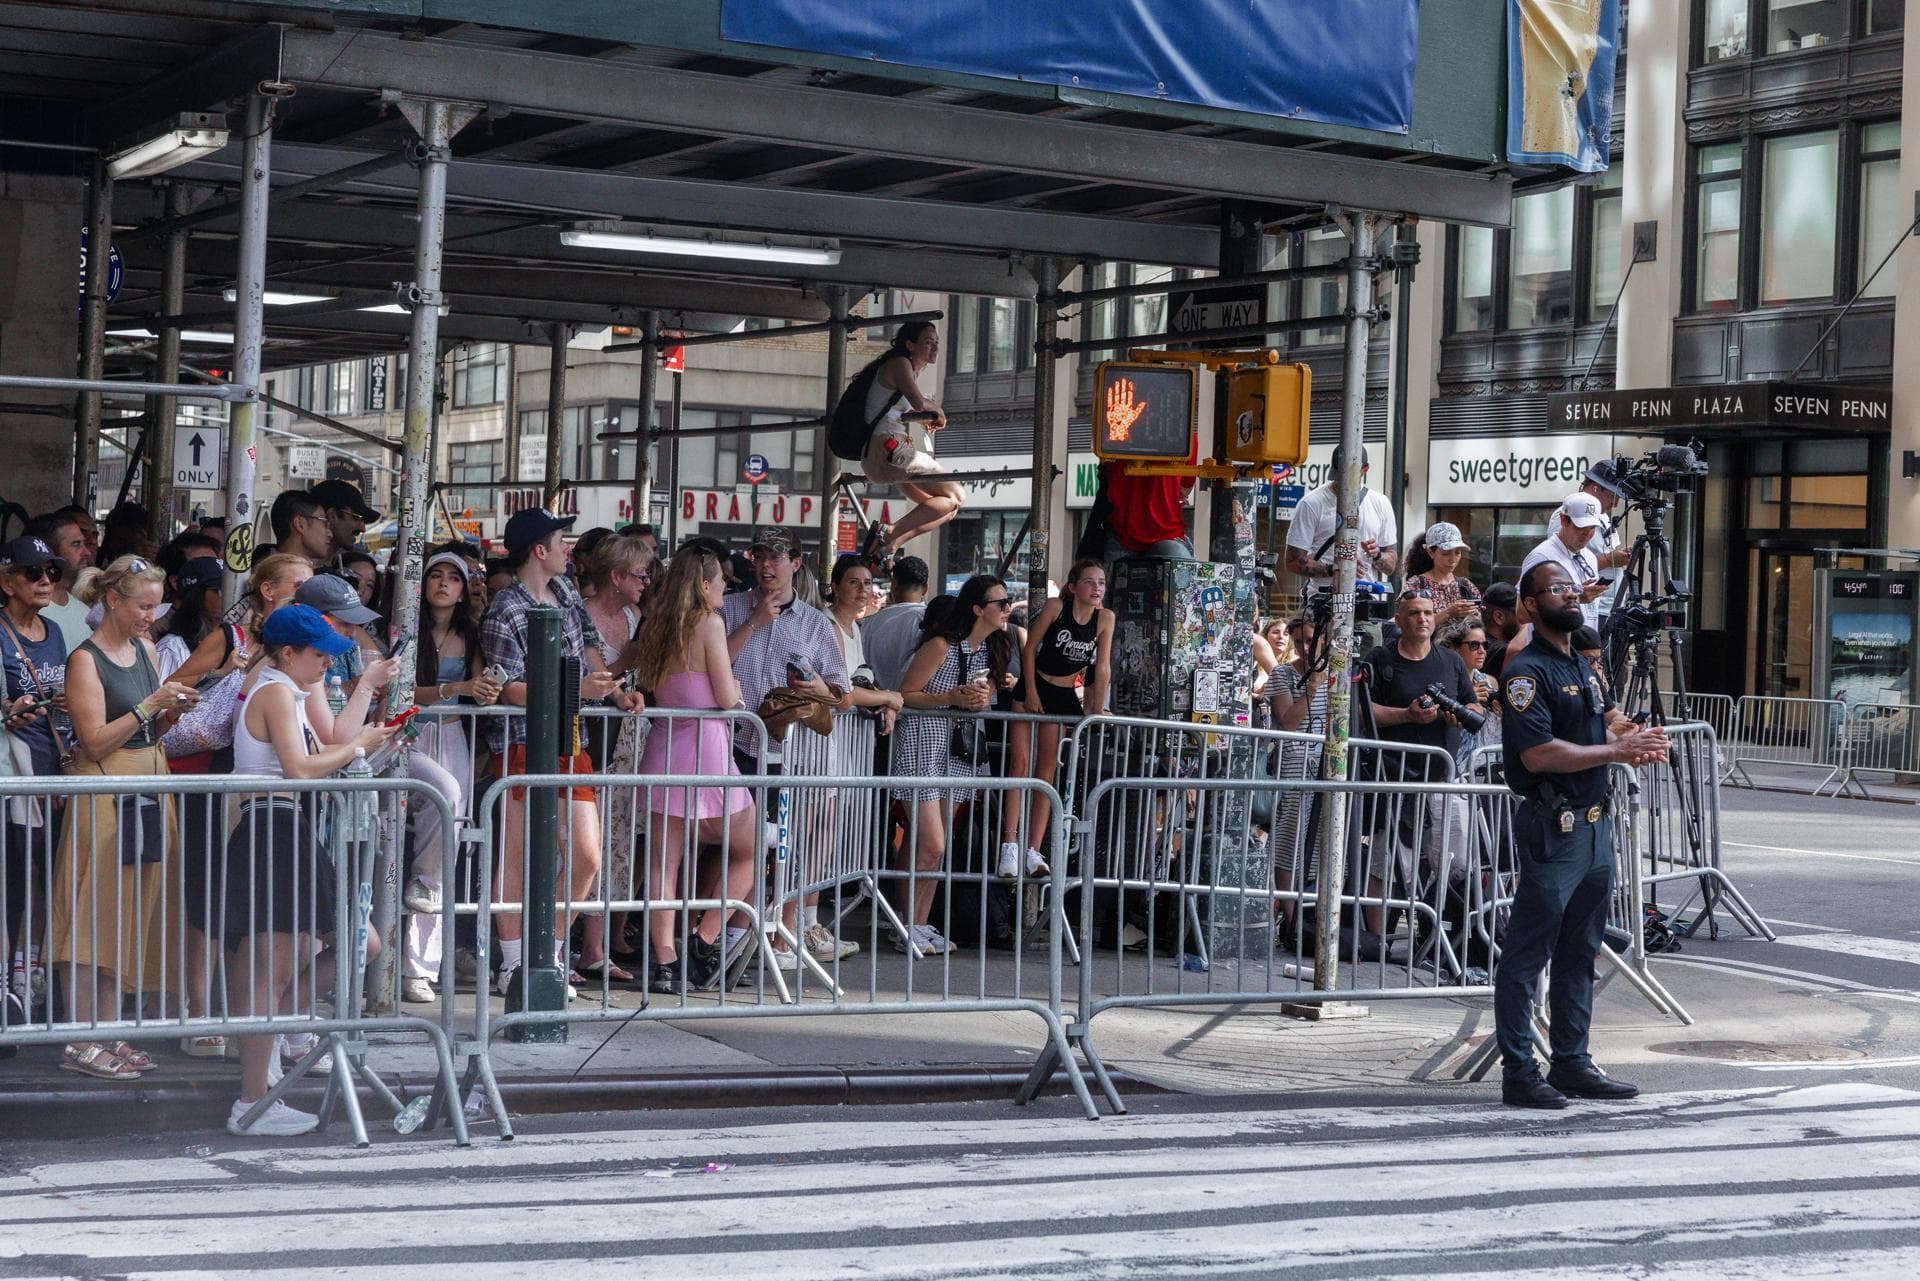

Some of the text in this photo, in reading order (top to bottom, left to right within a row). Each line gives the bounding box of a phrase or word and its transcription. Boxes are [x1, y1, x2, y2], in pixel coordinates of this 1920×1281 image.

[1181, 303, 1253, 331] ONE WAY
[373, 357, 386, 409] NAILS
[1565, 396, 1744, 421] SEVEN PENN PLAZA
[1774, 396, 1887, 419] SEVEN PENN
[178, 470, 214, 483] ONLY
[1449, 452, 1590, 488] sweetgreen
[683, 490, 785, 524] BRAO
[778, 793, 788, 861] NYPD
